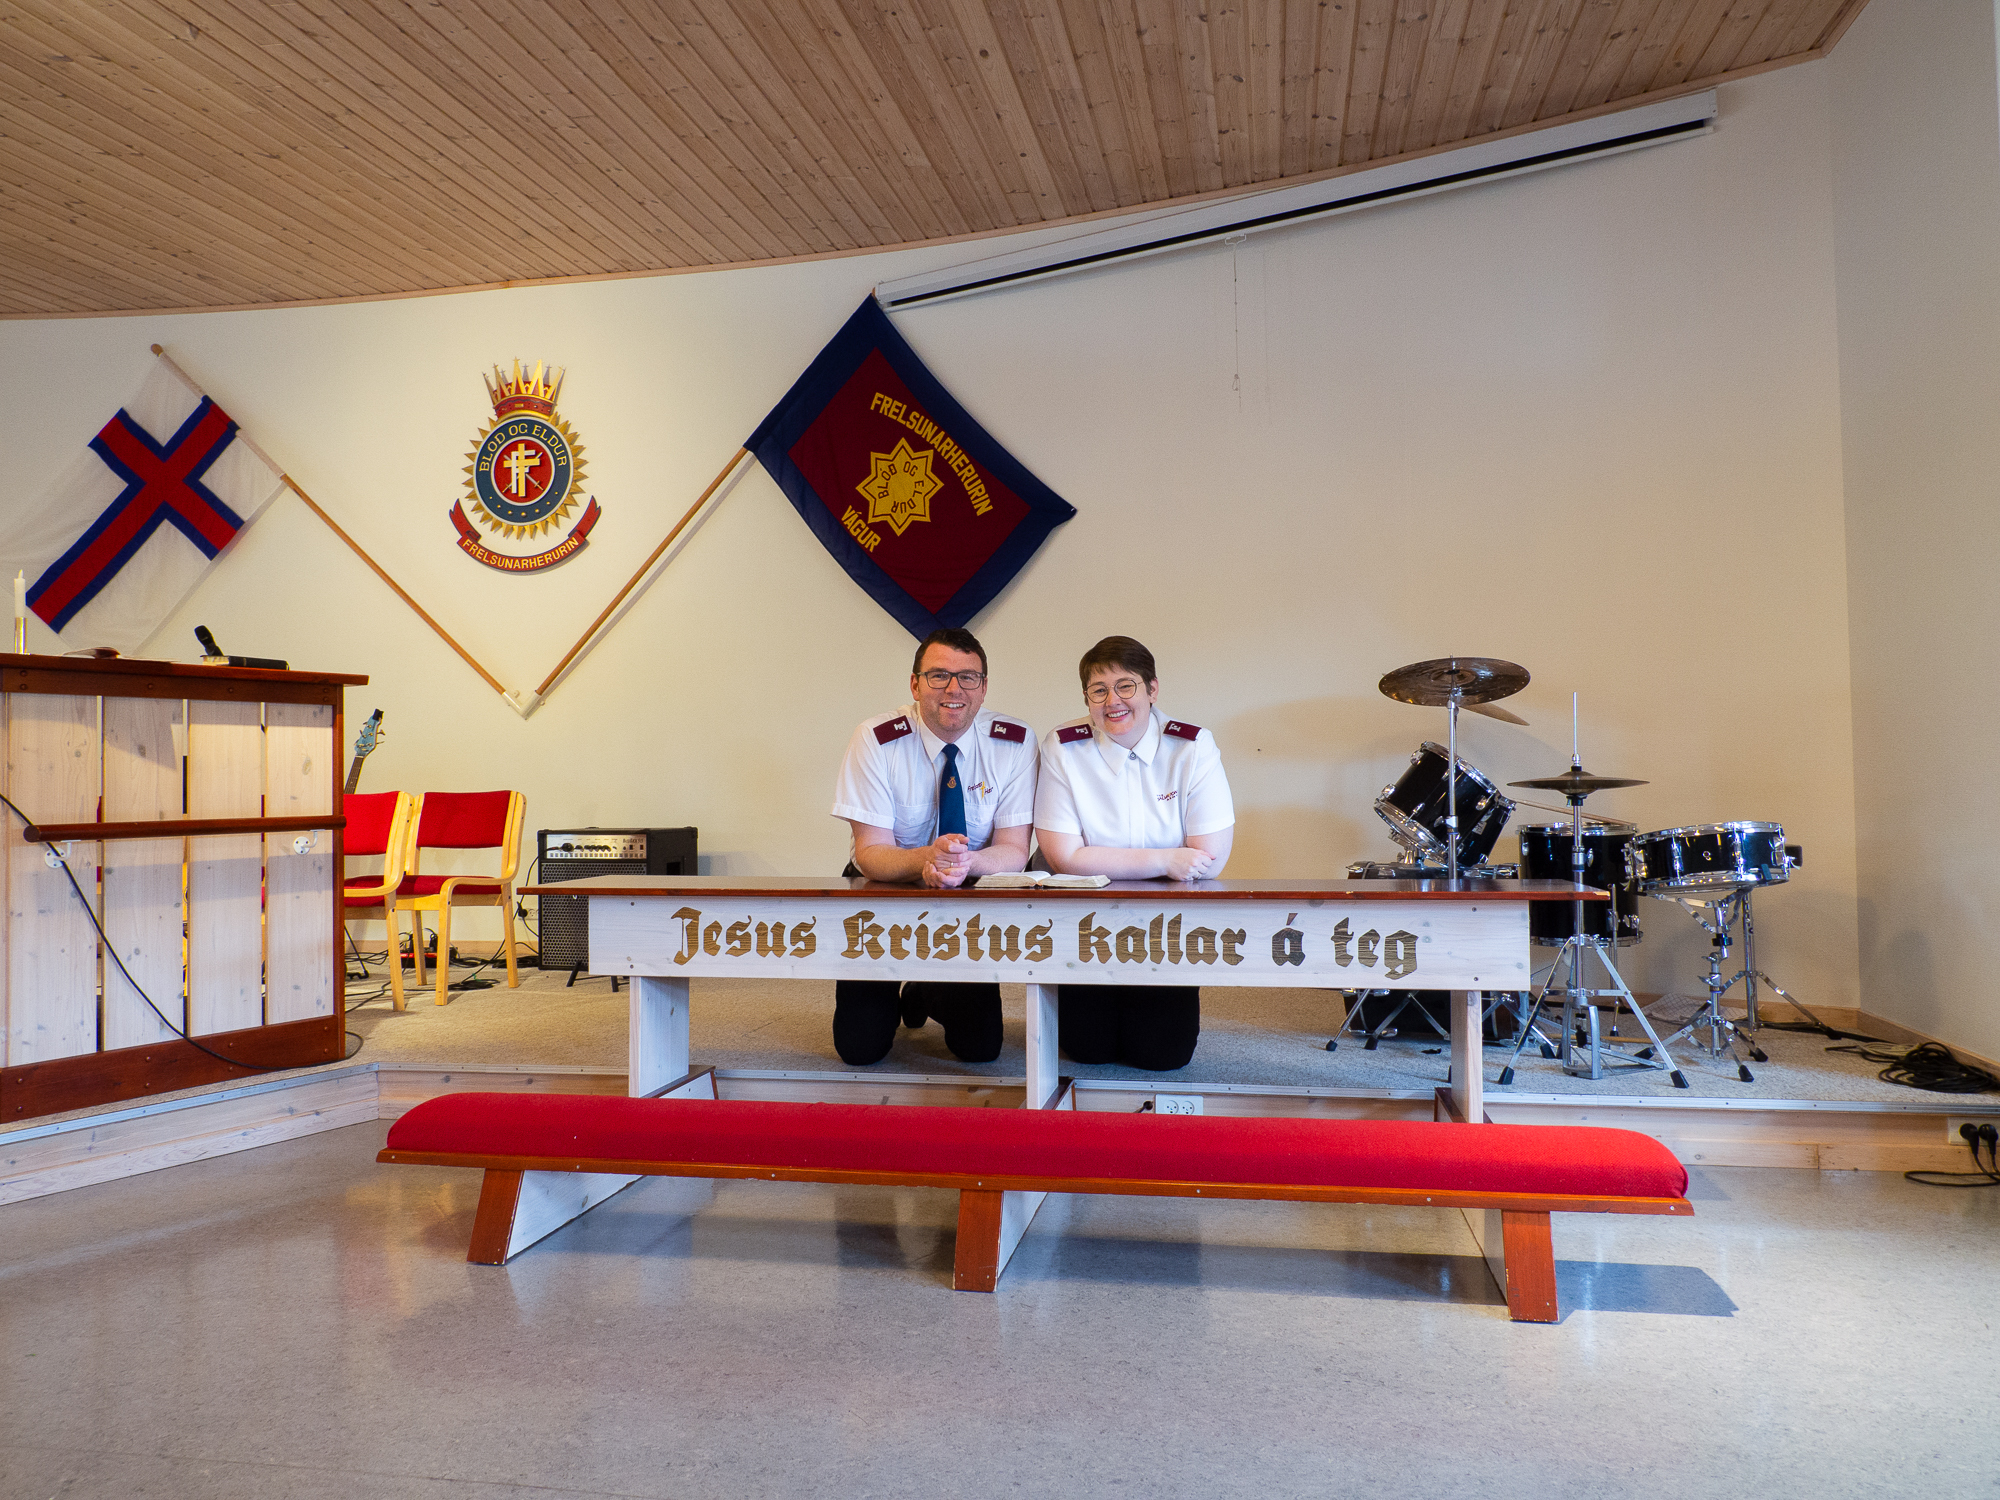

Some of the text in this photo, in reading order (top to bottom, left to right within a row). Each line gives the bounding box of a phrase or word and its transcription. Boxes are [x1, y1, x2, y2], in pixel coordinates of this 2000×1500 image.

[532, 424, 568, 467] ELDUR
[870, 392, 993, 516] FRELSUNARHERURIN
[903, 461, 918, 476] OG
[891, 480, 924, 514] ELDUR
[841, 505, 881, 553] VÁGUR
[462, 536, 579, 570] FRELSUNARHERURIN
[671, 906, 817, 966] Jesus
[1078, 911, 1247, 966] kallar
[1271, 912, 1306, 967] á
[1330, 916, 1419, 980] teg
